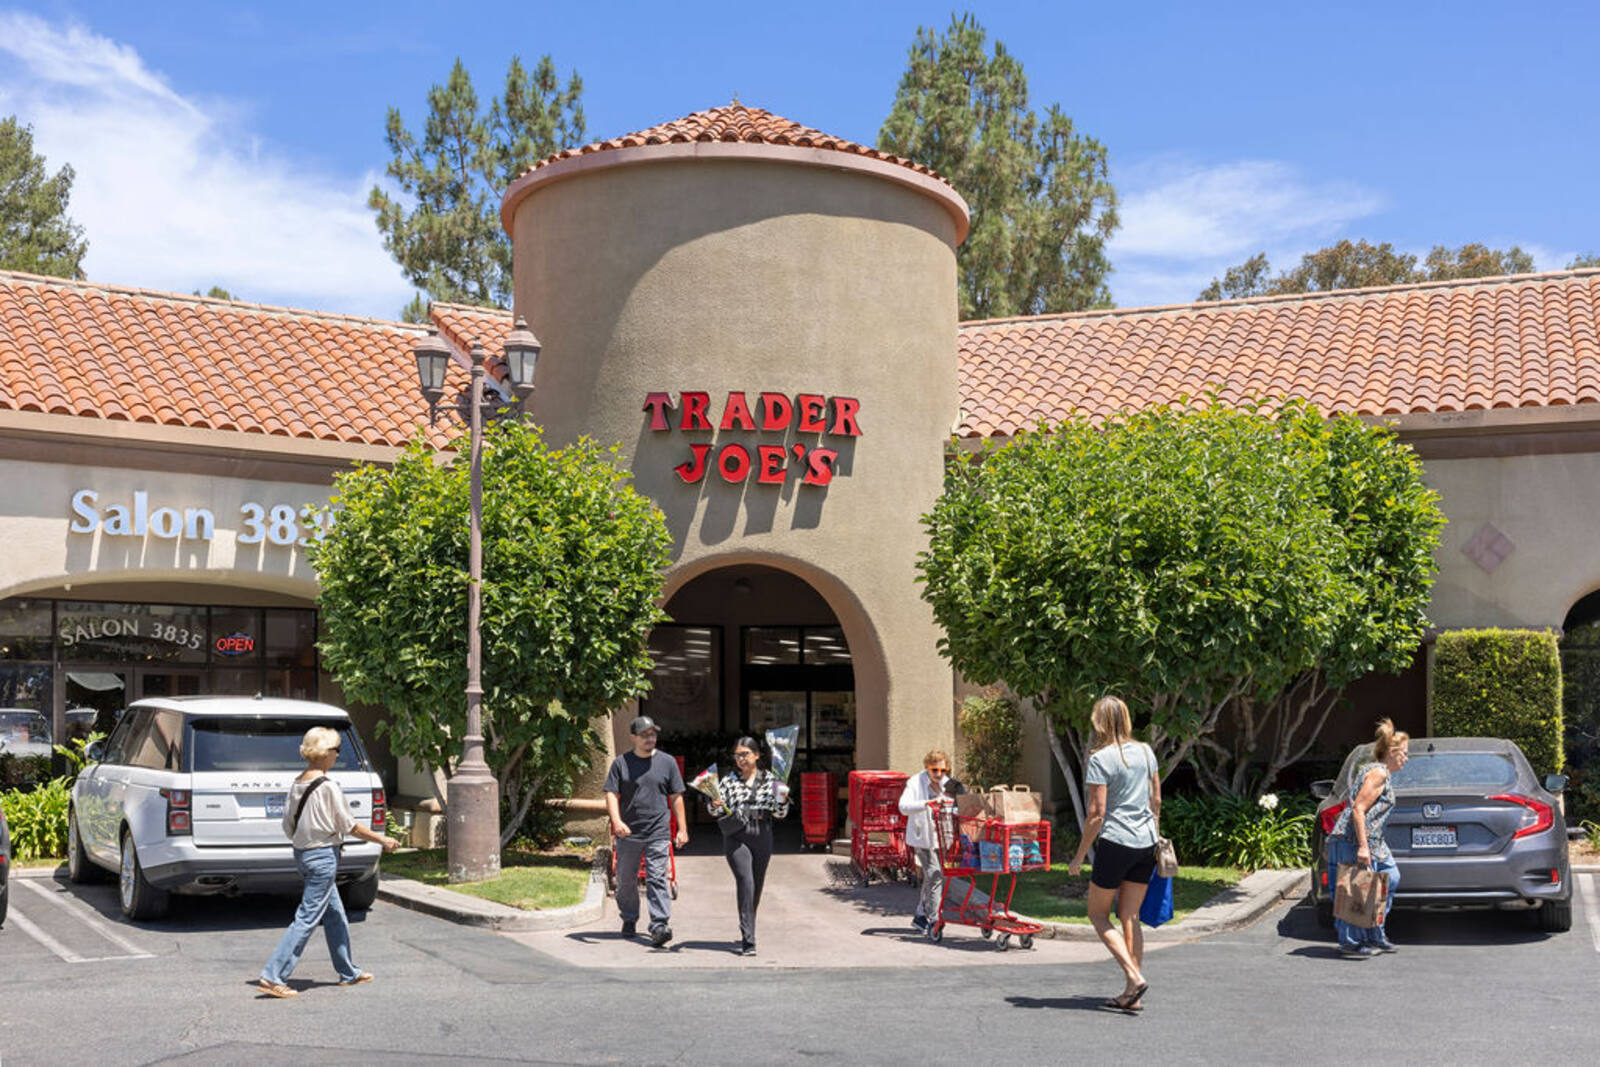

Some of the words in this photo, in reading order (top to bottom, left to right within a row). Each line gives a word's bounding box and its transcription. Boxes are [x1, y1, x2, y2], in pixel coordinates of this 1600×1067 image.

[642, 391, 862, 436] TRADER
[674, 443, 838, 486] JOE'S
[71, 489, 214, 540] Salon
[238, 502, 338, 547] 383
[60, 619, 139, 646] SALON
[150, 622, 203, 650] 3835
[216, 638, 254, 651] OPEN
